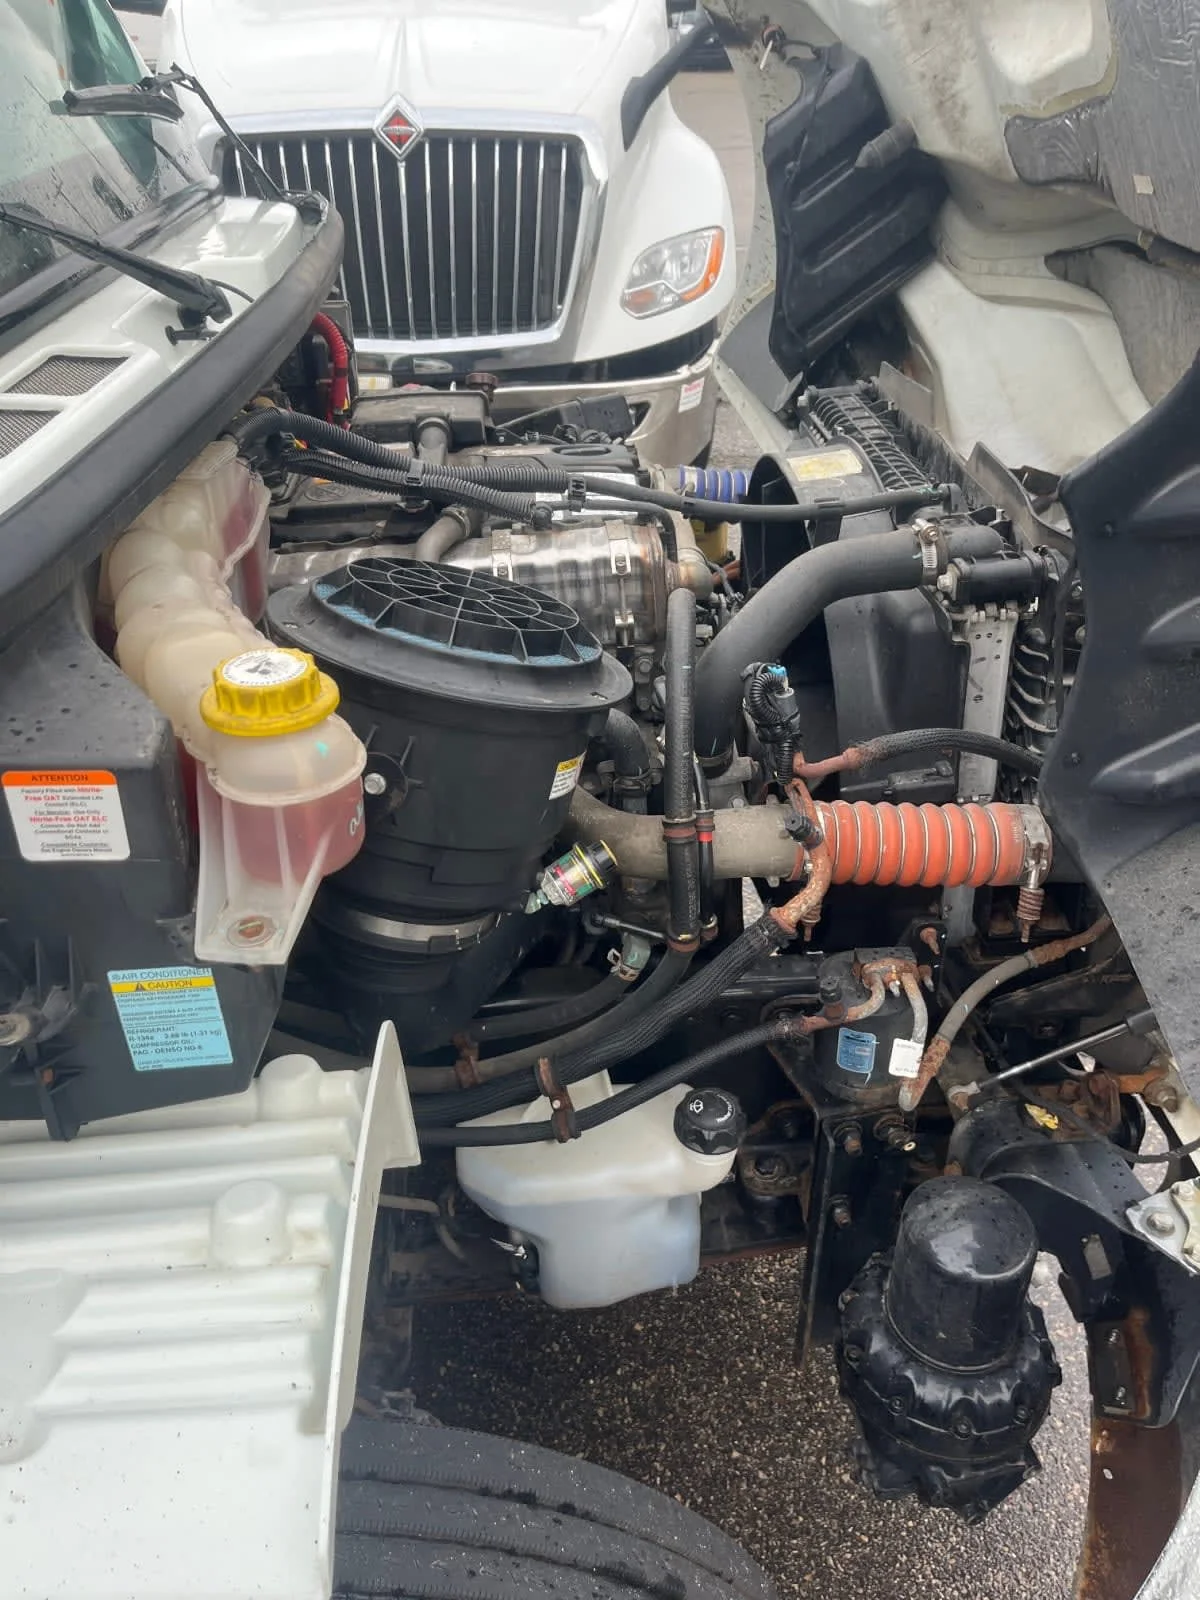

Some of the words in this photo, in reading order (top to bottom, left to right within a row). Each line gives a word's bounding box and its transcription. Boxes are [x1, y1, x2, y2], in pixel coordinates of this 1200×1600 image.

[31, 774, 89, 782] ATTENTION
[121, 972, 138, 981] AIR
[140, 967, 211, 980] CONDITIONER
[147, 980, 193, 989] CAUTION
